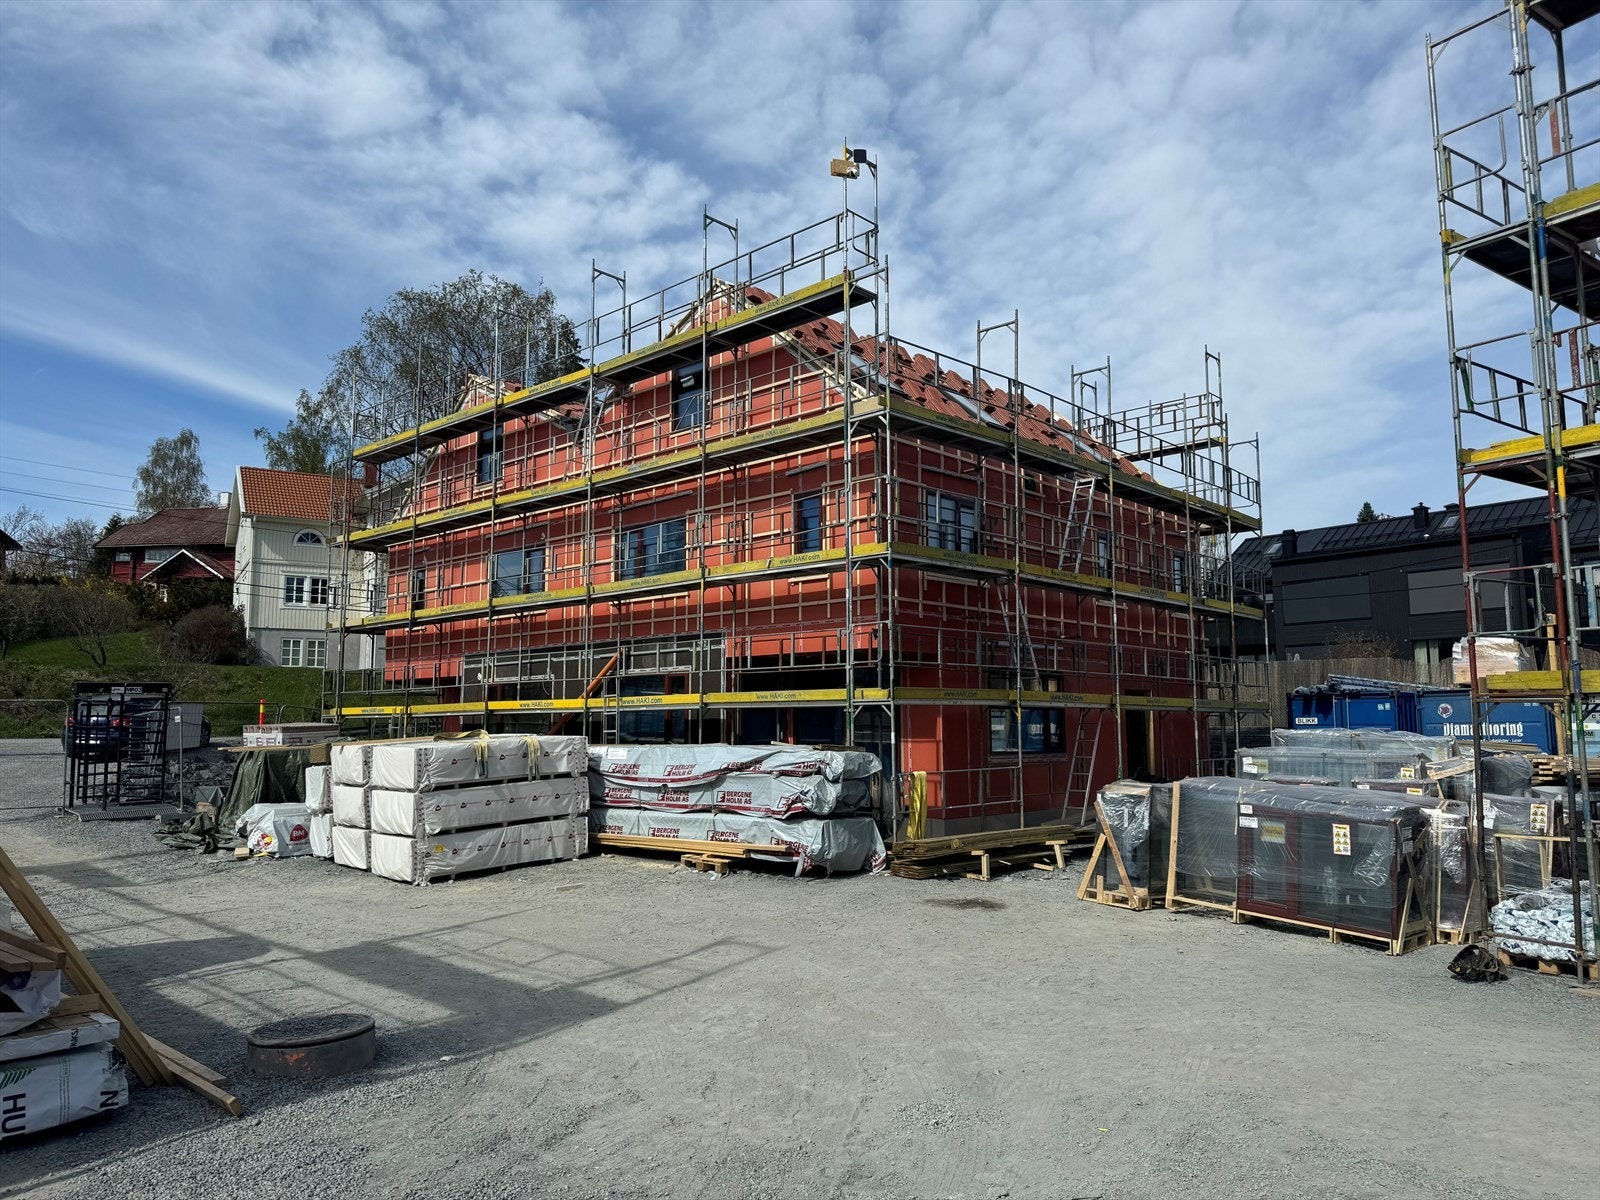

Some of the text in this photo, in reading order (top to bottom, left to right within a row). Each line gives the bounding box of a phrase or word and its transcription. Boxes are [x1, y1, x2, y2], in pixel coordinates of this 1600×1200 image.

[780, 553, 821, 565] www.HAKI.com
[755, 691, 797, 700] www.HAKI.com
[519, 700, 554, 708] www.HAKI.com
[622, 697, 663, 705] www.HAKI.com
